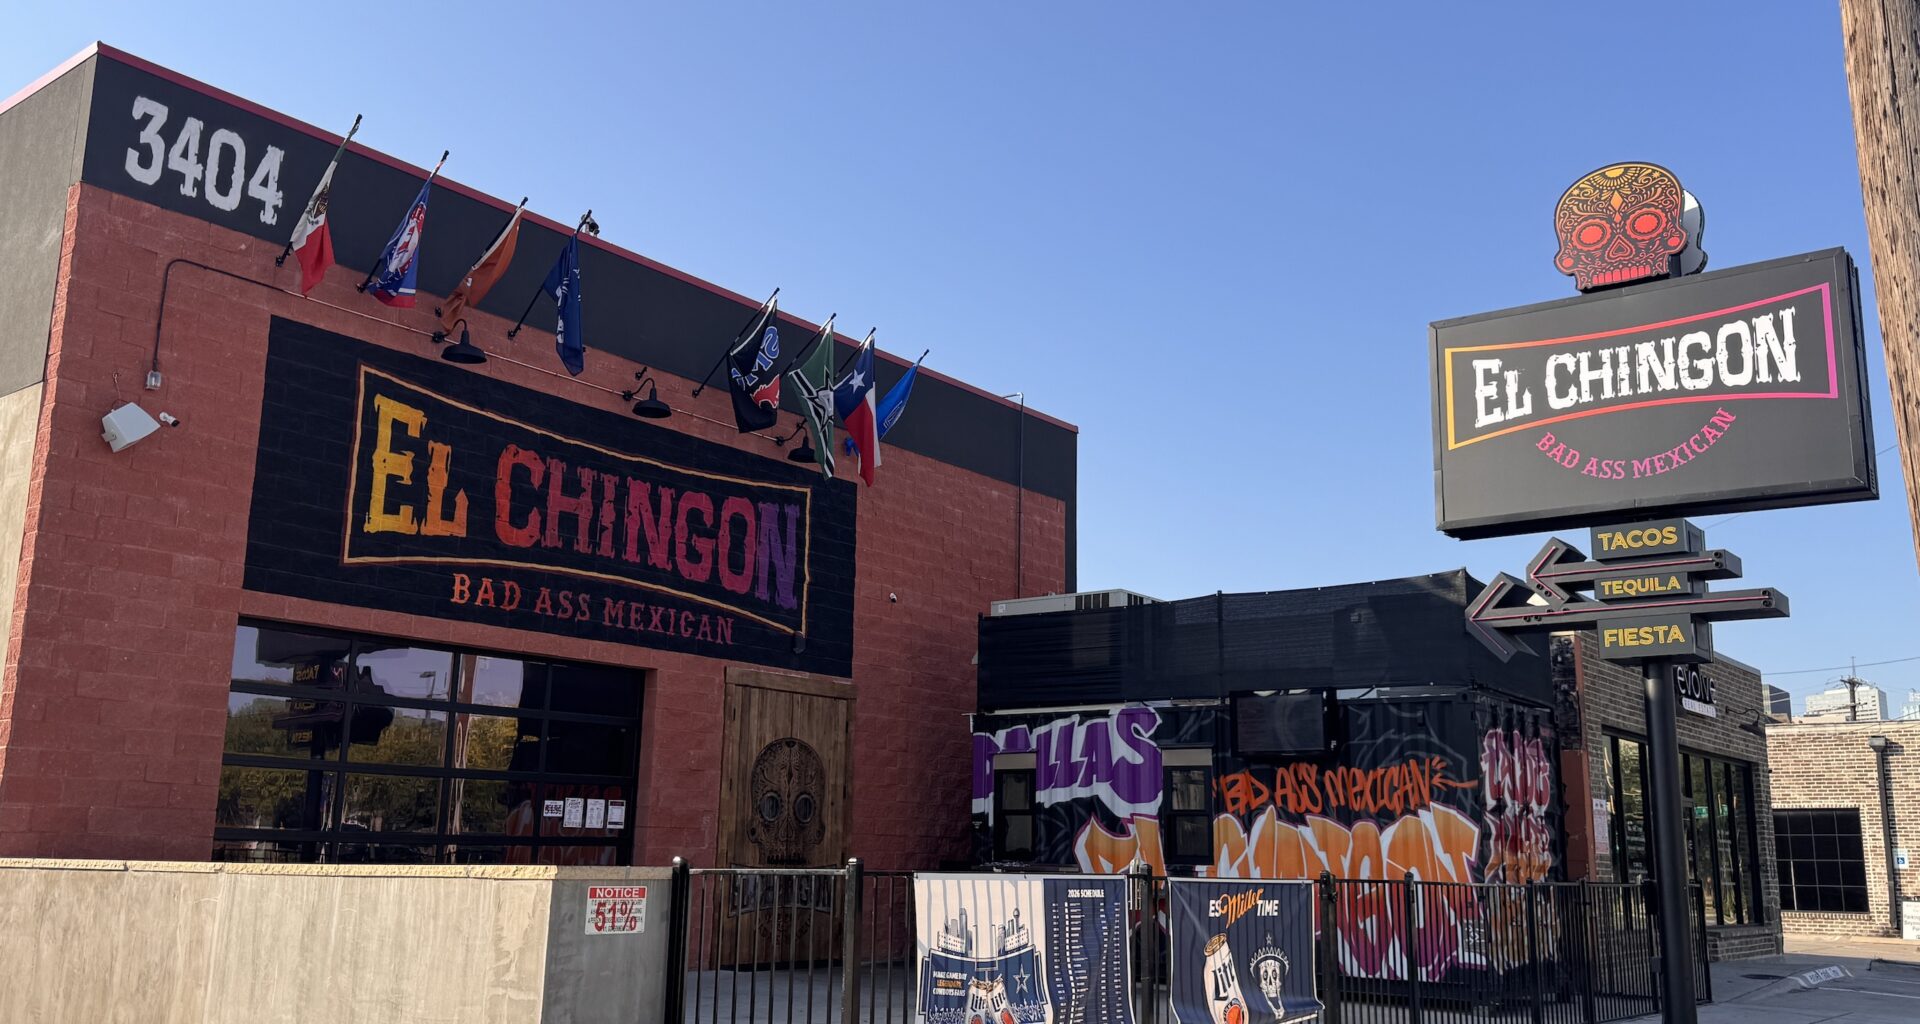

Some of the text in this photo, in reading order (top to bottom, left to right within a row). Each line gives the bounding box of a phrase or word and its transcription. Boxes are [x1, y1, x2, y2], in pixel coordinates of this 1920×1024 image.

[125, 95, 285, 226] 3404
[1473, 306, 1801, 428] EL CHINGON
[1536, 407, 1737, 480] BAD ASS MEXICAN
[363, 393, 800, 610] EL CHINGON
[1597, 526, 1679, 551] TACOS
[1601, 575, 1681, 596] TEQUILA
[450, 573, 735, 645] BAD ASS MEXICAN
[1603, 622, 1685, 649] FIESTA
[1677, 666, 1717, 704] evolve
[972, 703, 1163, 818] DLLAS
[1274, 762, 1324, 814] ASS
[596, 888, 640, 898] NOTICE
[1081, 889, 1105, 898] SCHEDULE
[1219, 887, 1264, 929] Miller
[1257, 899, 1280, 917] TIME
[594, 901, 637, 932] 51%
